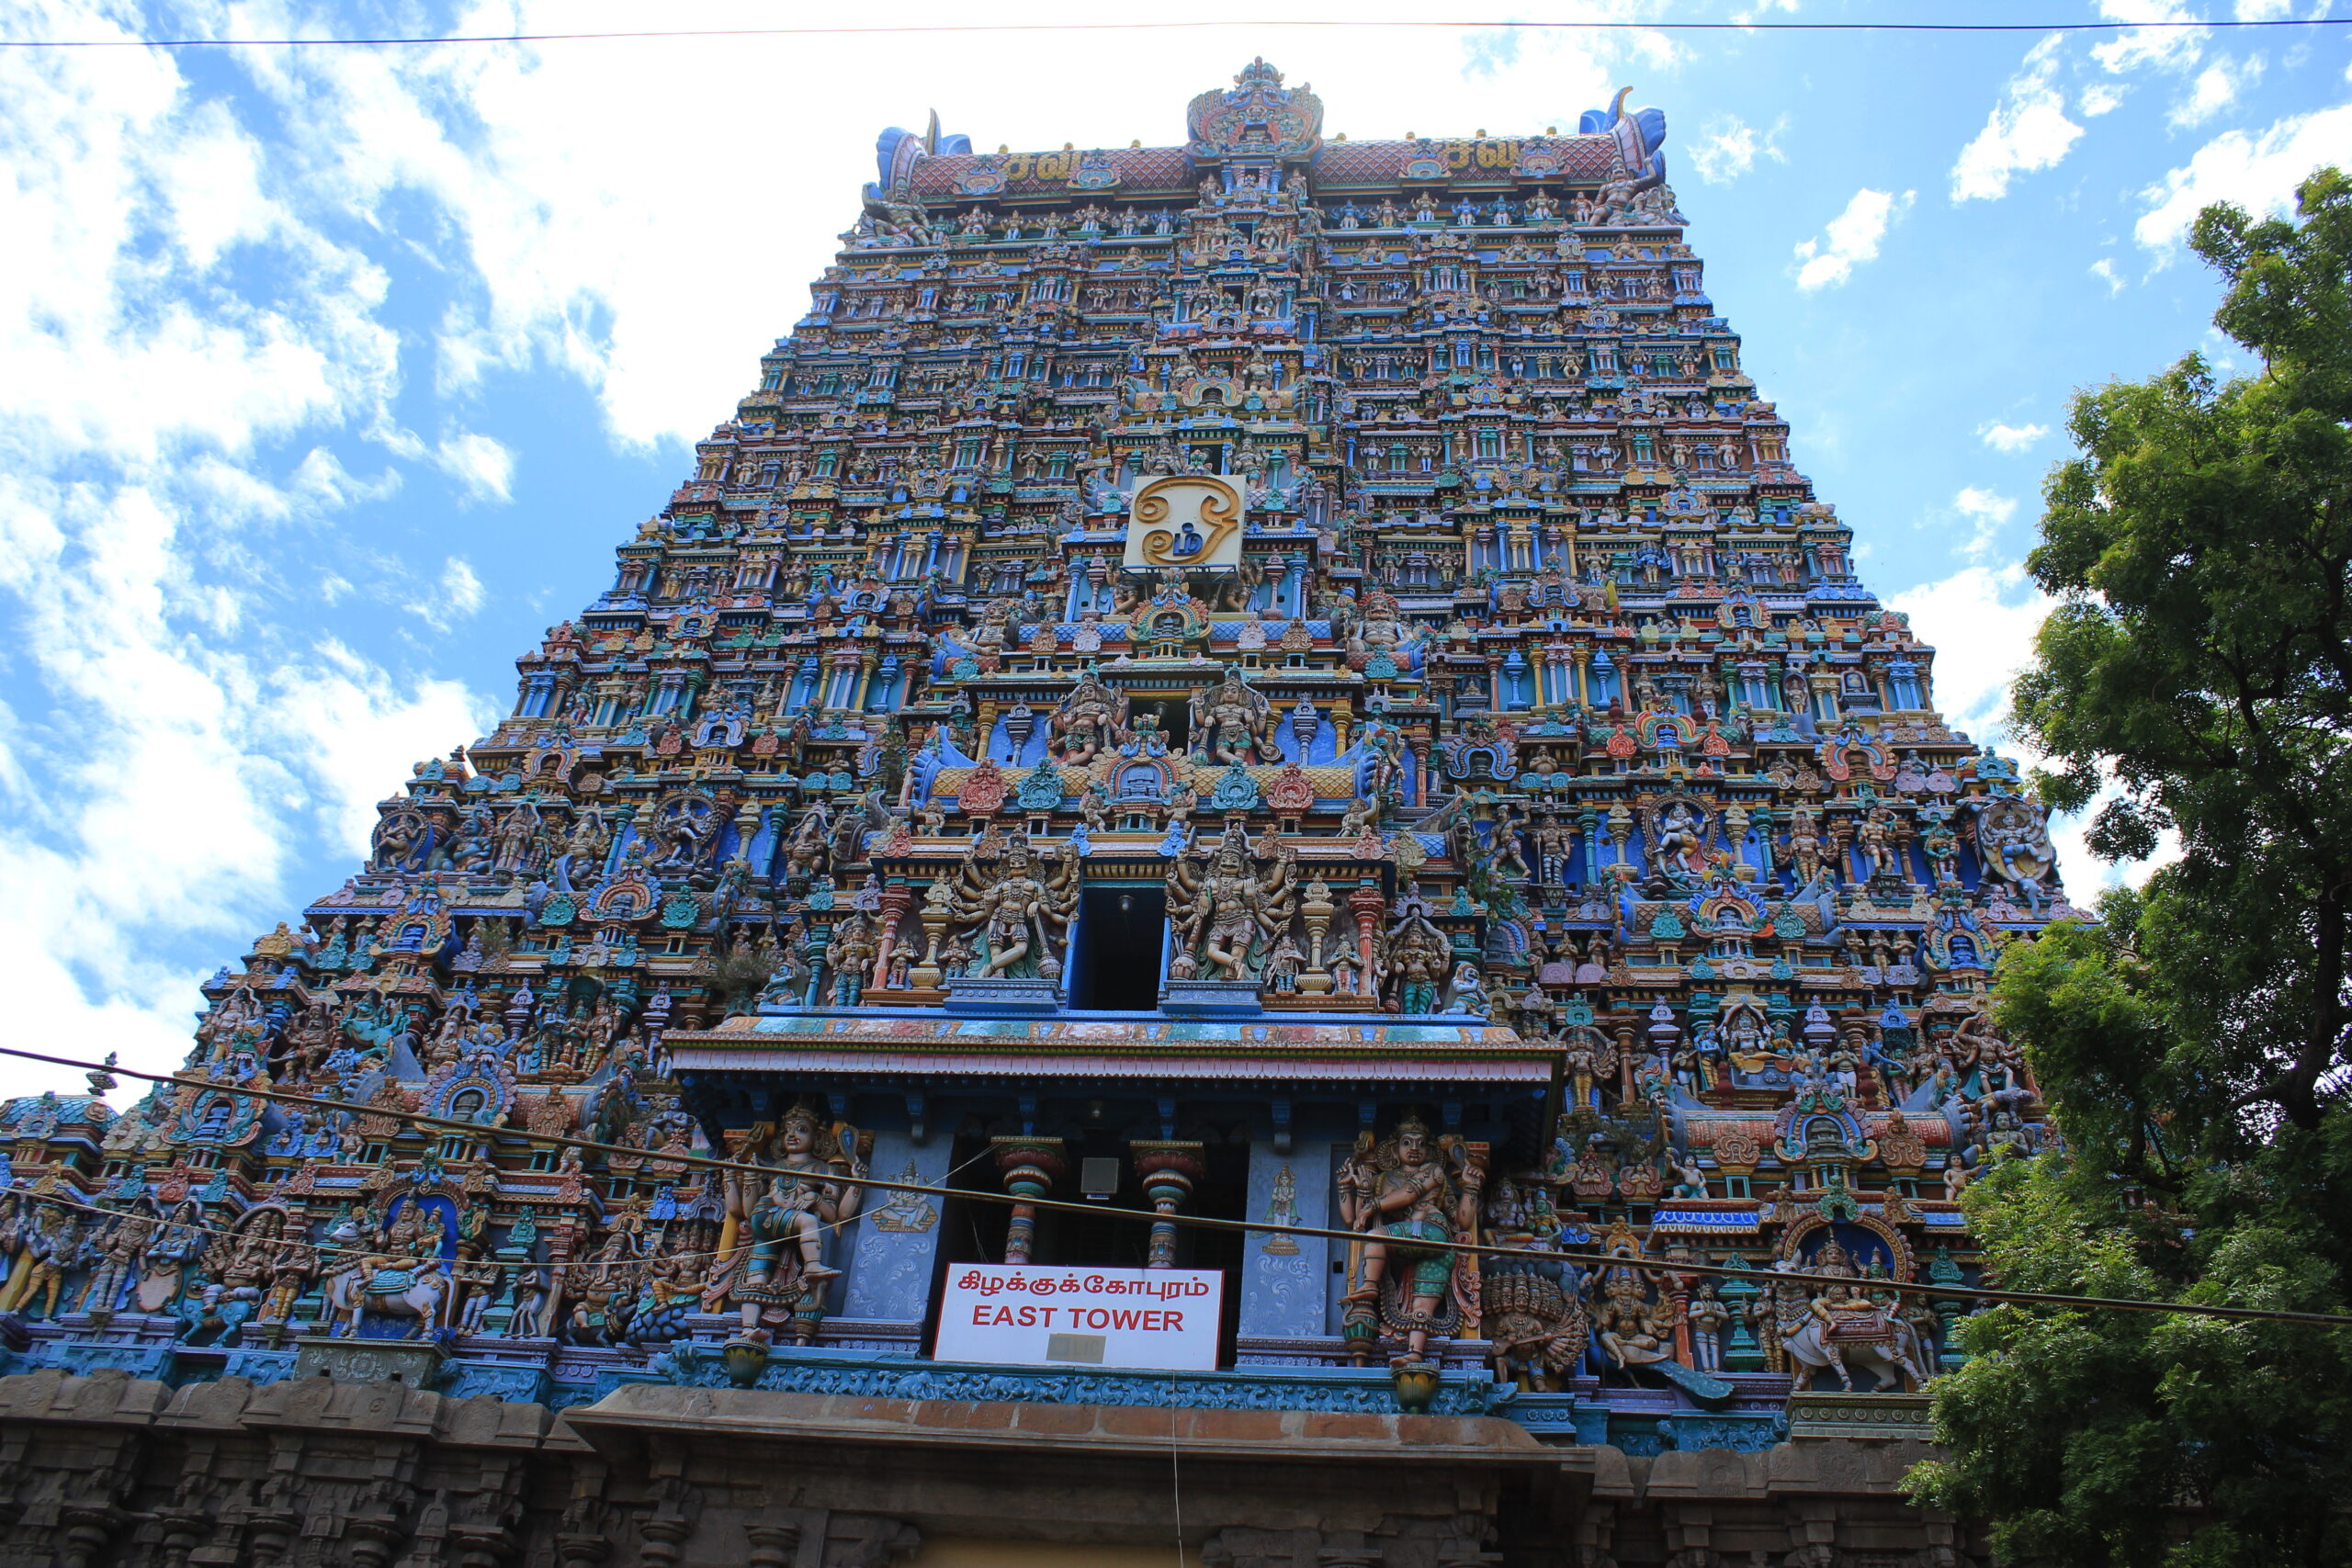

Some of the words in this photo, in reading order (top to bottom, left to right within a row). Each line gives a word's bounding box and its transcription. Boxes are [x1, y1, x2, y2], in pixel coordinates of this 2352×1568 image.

[1135, 476, 1238, 565] ஓம்
[957, 1270, 1209, 1302] கிழக்குக்கோபுரம்
[972, 1305, 1058, 1327] EAST
[1068, 1308, 1183, 1331] TOWER
